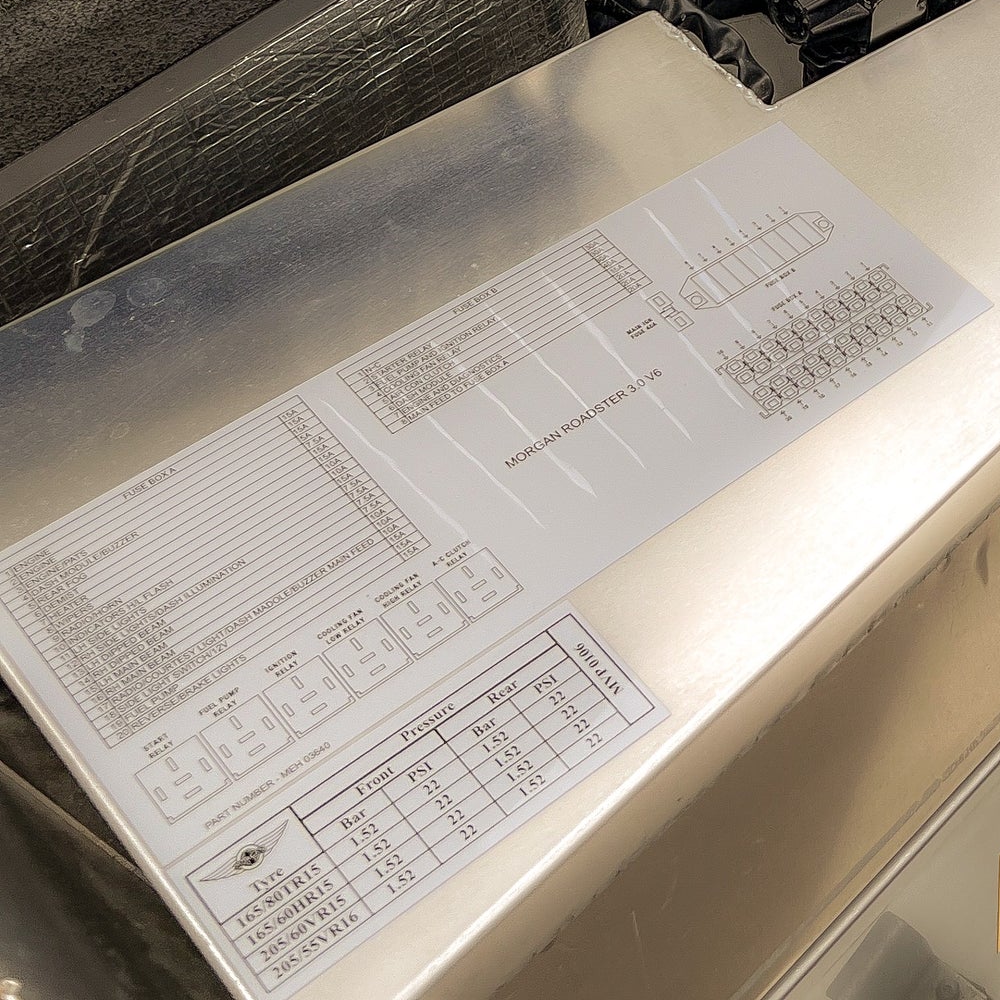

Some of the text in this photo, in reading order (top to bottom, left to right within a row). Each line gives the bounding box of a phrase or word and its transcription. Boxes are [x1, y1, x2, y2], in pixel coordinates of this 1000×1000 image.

[452, 301, 473, 313] FUSE
[473, 292, 490, 302] BOX
[504, 368, 662, 468] MORGAN ROADSTER 3.0 V6
[123, 483, 148, 499] FUSE
[149, 471, 170, 484] BOX
[401, 701, 454, 740] Pressure
[574, 642, 623, 693] MVP 0106
[204, 742, 330, 829] PART NUMBER MEH 03640
[250, 674, 557, 895] Tyre Bar PSI Bar PSI
[356, 679, 518, 794] Front Rear
[236, 690, 565, 927] 165/80TR15 1.52 22 1.52 22
[247, 705, 577, 944] 165/60HR15 1.52 22 1.52 22
[260, 719, 590, 961] 205/60VR15 1.52 22 1.52 22
[272, 733, 602, 978] 205/55VR16 1.52 22 1.52 22
